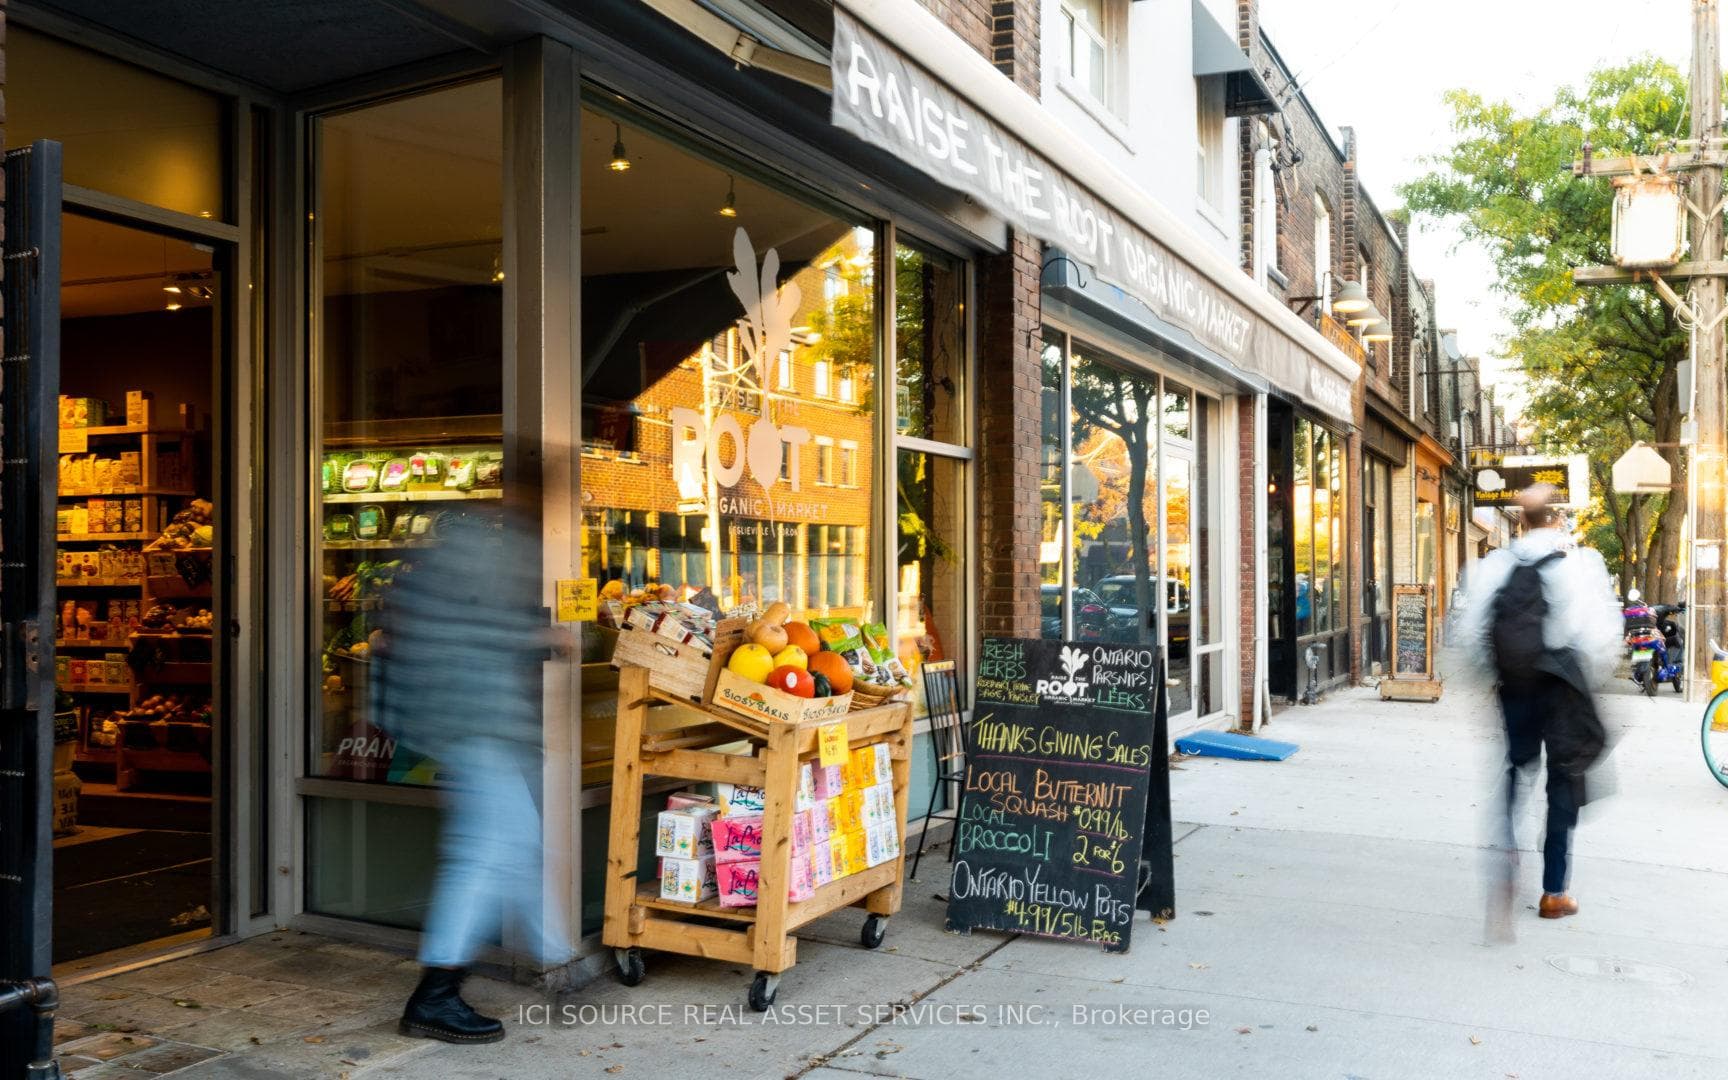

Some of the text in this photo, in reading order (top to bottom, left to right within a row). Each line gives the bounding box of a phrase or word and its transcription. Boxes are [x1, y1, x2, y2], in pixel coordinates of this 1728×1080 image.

[847, 41, 978, 176] RAISE
[983, 133, 1051, 220] THE
[1052, 184, 1114, 266] ROOT
[1124, 237, 1196, 317] ORGANIC
[1199, 290, 1250, 352] MARKET
[983, 639, 1025, 660] FRESH
[1093, 646, 1152, 668] ONTARIO
[980, 660, 1027, 681] HERBS
[1036, 679, 1089, 697] ROOT
[1097, 689, 1145, 710] LEEKS
[338, 736, 398, 759] PRAN
[1106, 731, 1150, 766] SALES
[966, 764, 1133, 809] LOCAL BUTTERNUT
[961, 796, 1016, 827] LOCAL
[990, 793, 1069, 822] SQUASH
[959, 822, 1054, 861] BROCCOLI
[1073, 835, 1090, 865] 2
[1093, 845, 1112, 861] FOR
[953, 860, 1131, 926] ONTARIO YELLOW POTS
[1091, 919, 1122, 944] BAG
